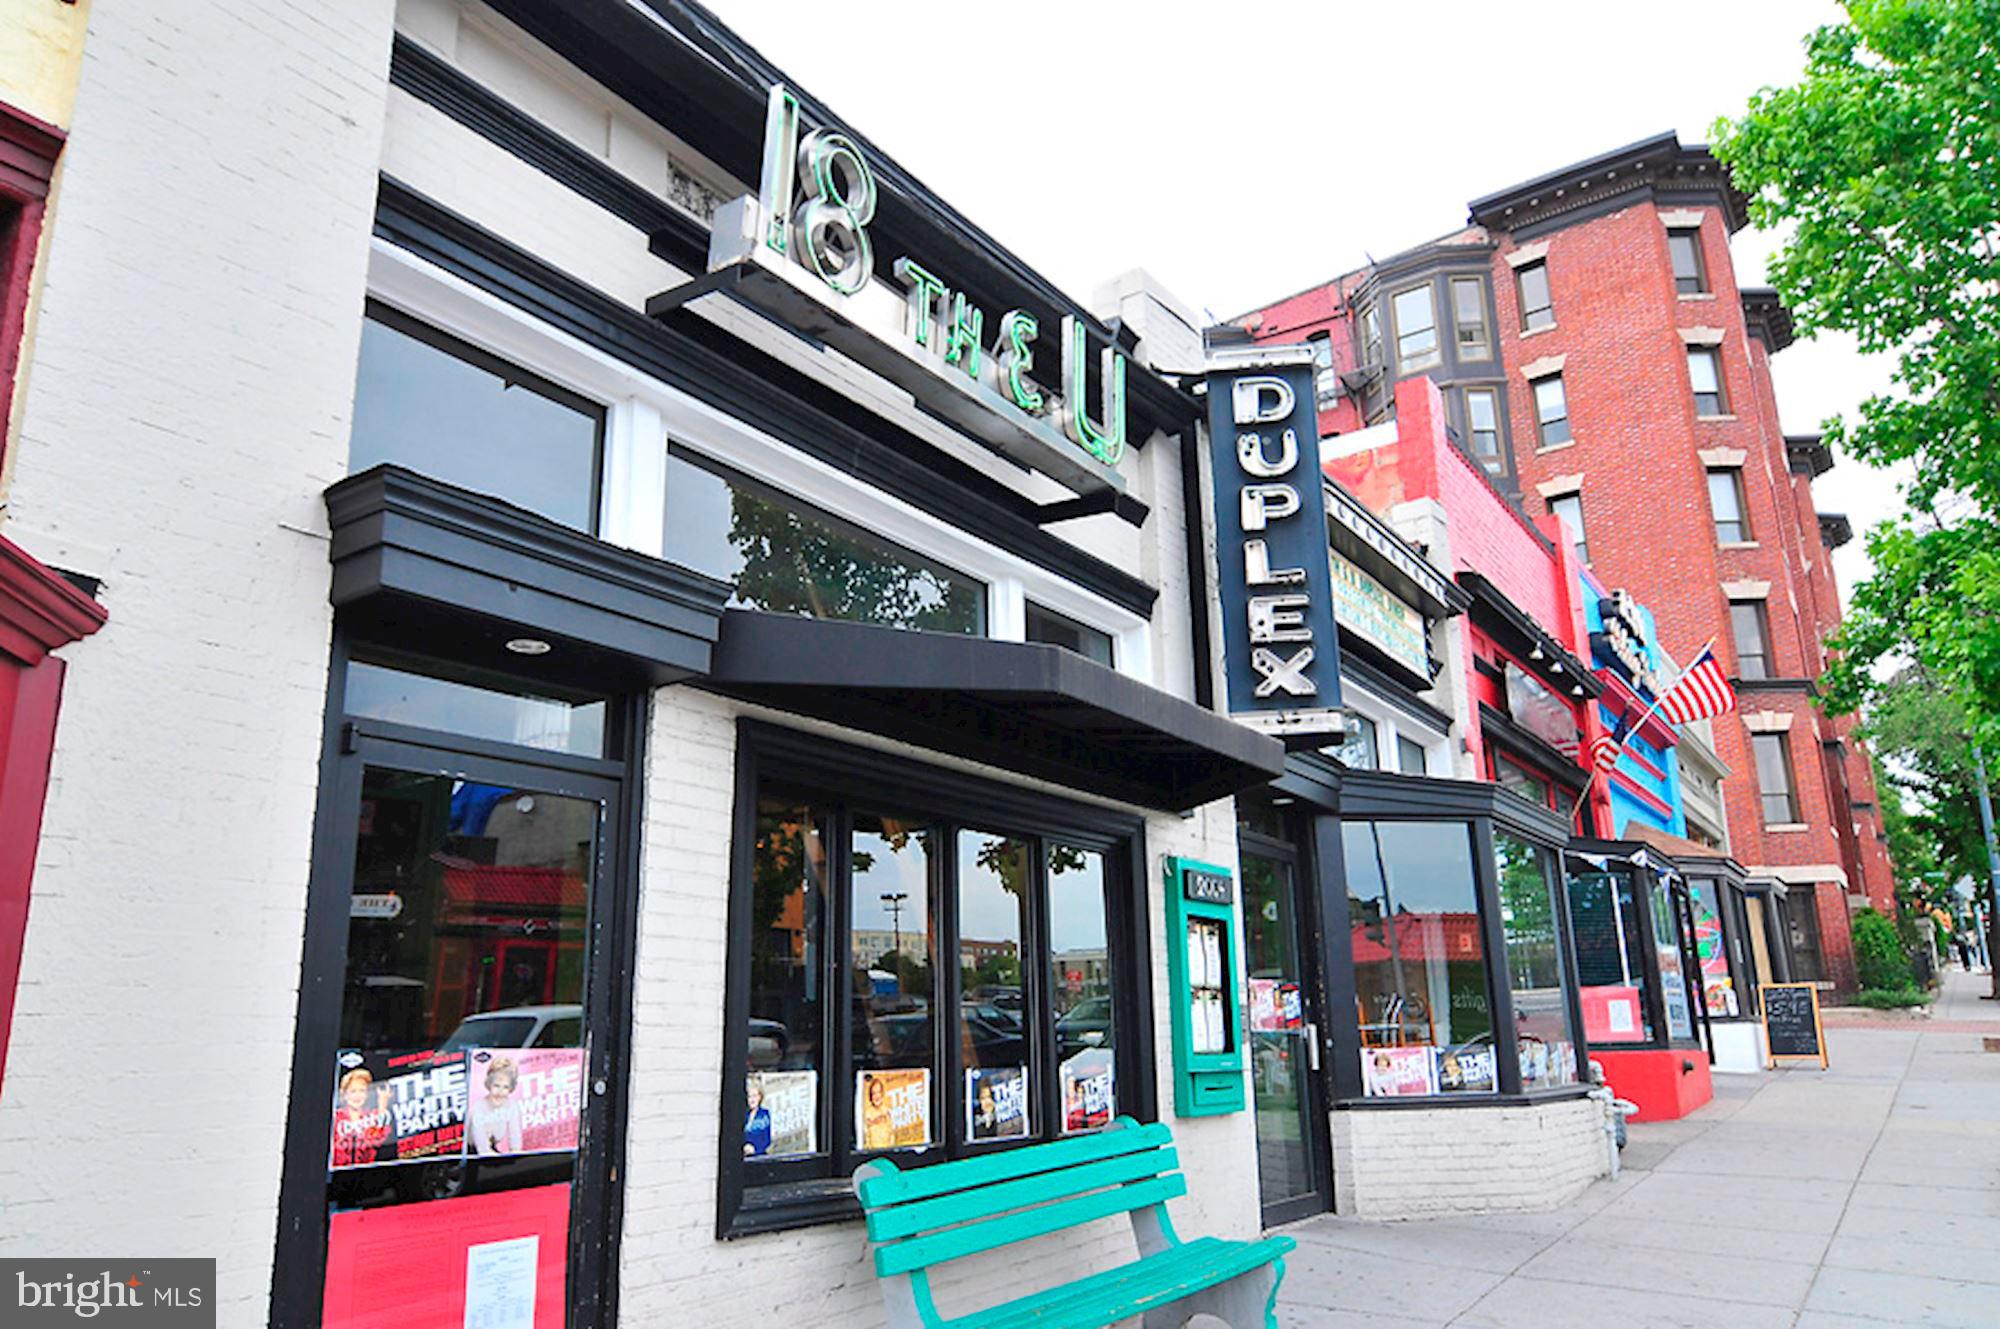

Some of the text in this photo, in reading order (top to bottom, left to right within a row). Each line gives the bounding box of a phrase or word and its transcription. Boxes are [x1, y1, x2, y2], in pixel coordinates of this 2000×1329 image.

[758, 81, 877, 297] 18
[1060, 314, 1126, 464] U
[1231, 376, 1318, 698] DUPLEX
[1457, 1052, 1491, 1071] THE
[388, 1062, 467, 1104] THE
[519, 1064, 580, 1099] THE
[886, 1081, 924, 1108] THE
[990, 1077, 1023, 1102] THE
[1081, 1073, 1109, 1096] THE
[392, 1091, 467, 1121] WHITE
[520, 1089, 580, 1114] WHITE
[766, 1083, 809, 1112] THE
[396, 1105, 467, 1138] PARTY
[522, 1104, 580, 1129] PARTY
